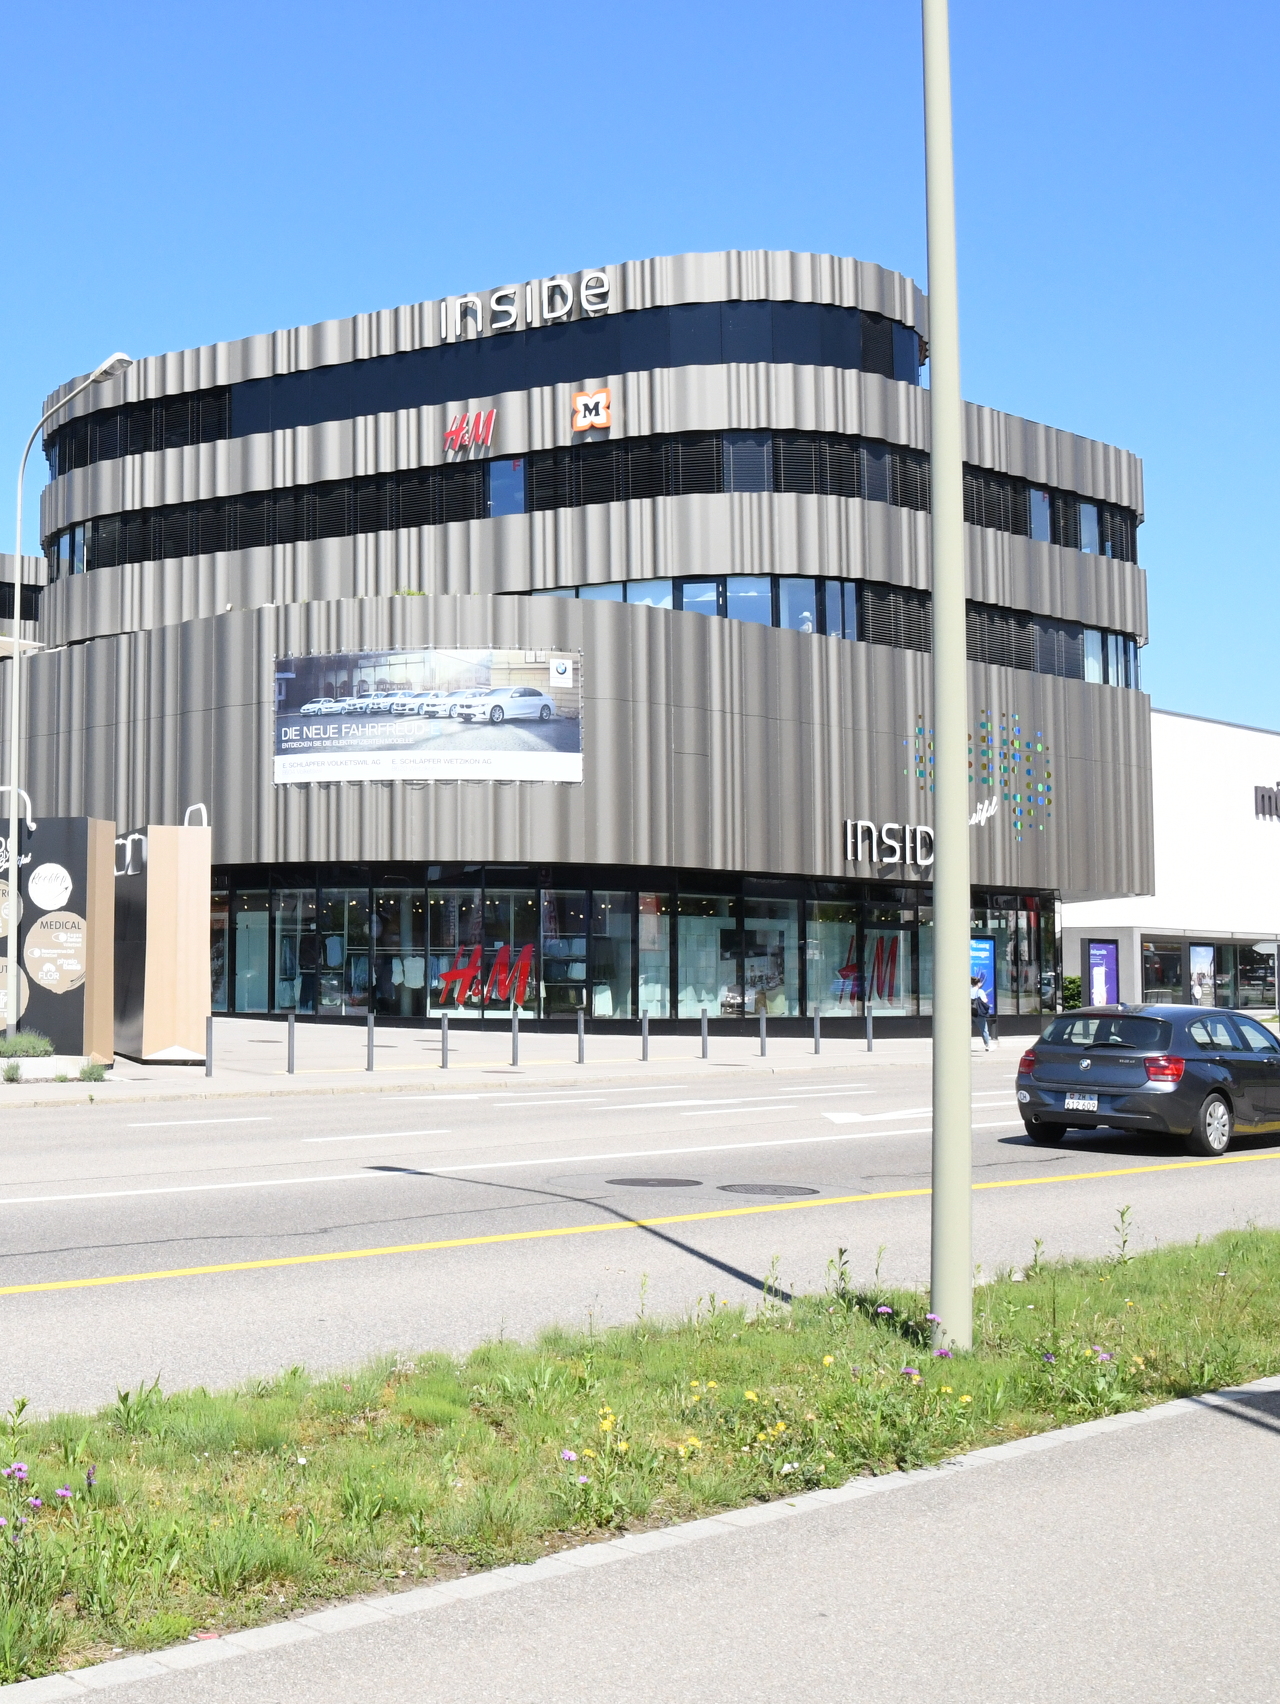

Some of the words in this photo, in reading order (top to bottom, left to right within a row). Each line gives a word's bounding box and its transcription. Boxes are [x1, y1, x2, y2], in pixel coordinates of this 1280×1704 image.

[443, 408, 497, 452] H&M
[282, 727, 301, 741] DIE
[303, 725, 339, 739] NEUE
[40, 921, 81, 929] MEDICAL
[438, 944, 535, 1007] H&M
[1066, 1101, 1080, 1109] 612
[1081, 1103, 1096, 1111] 609
